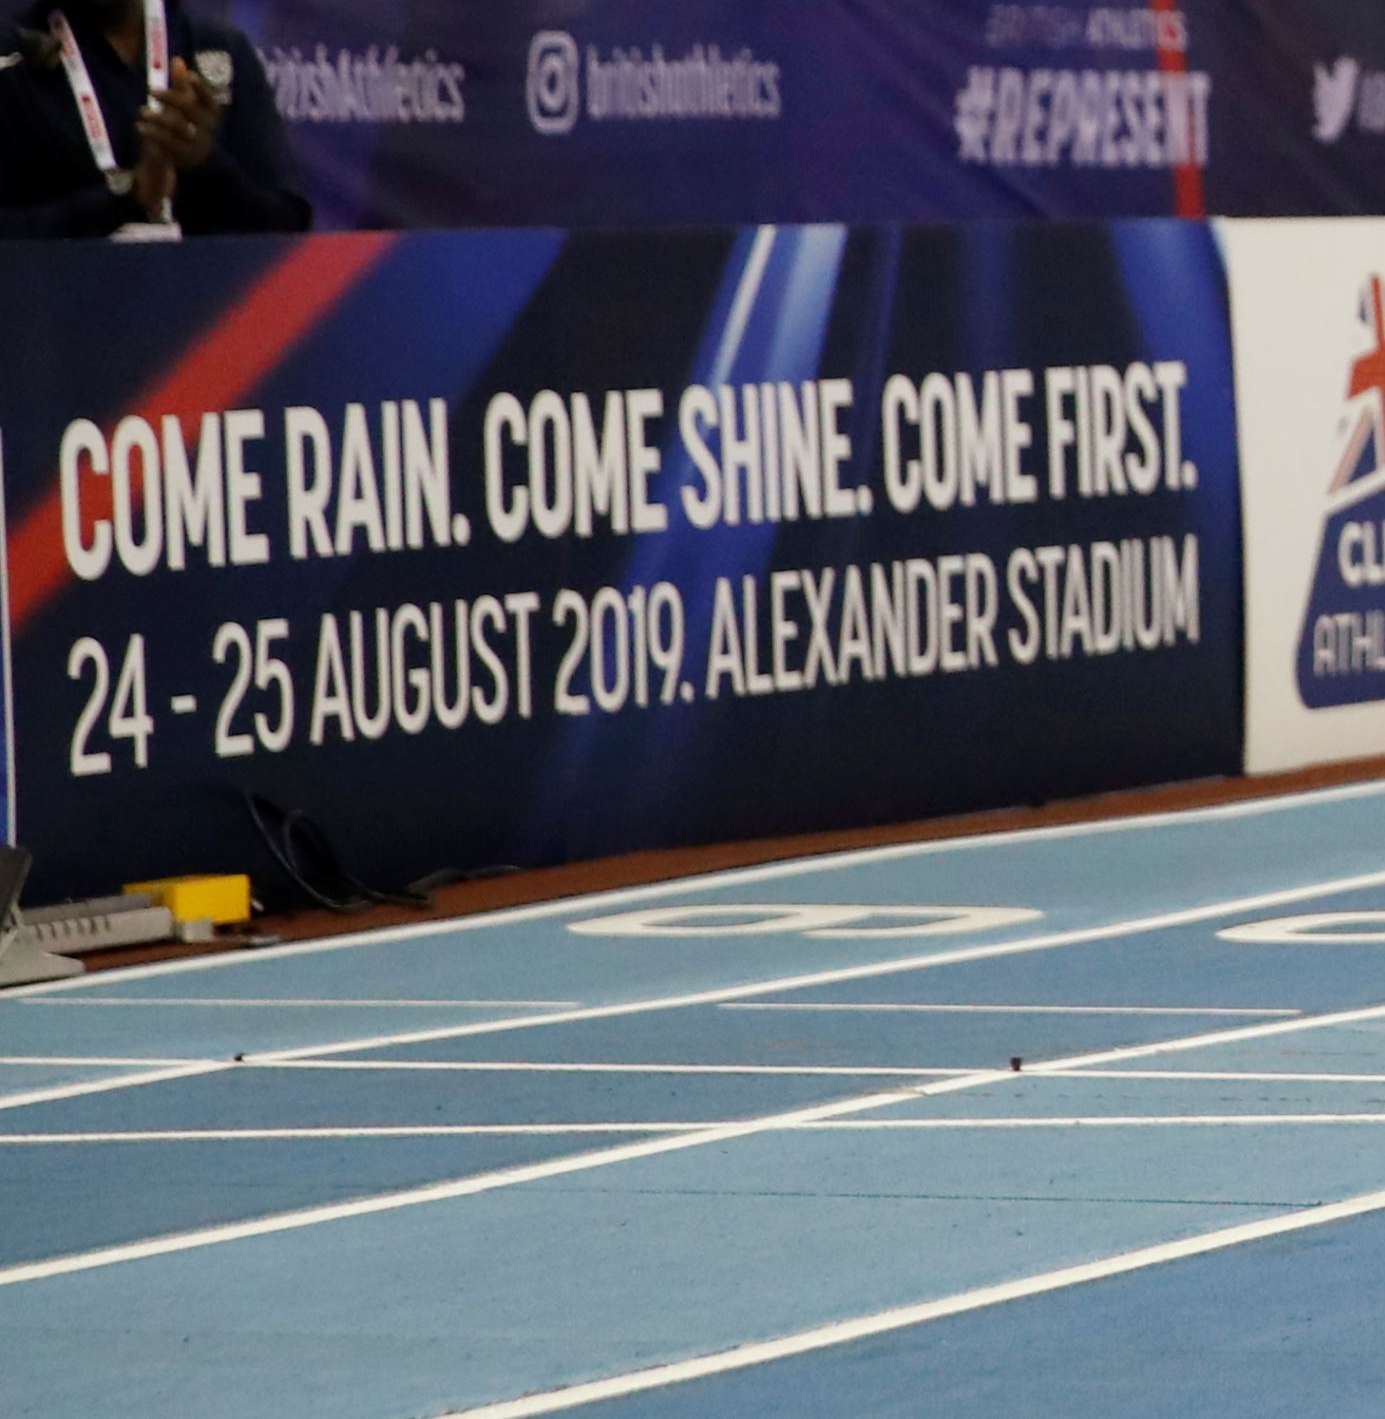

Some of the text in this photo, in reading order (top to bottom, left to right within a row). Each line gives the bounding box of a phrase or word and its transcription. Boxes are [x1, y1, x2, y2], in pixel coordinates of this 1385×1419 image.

[60, 360, 1197, 581] COME RAIN. COME SHINE. COME FIRST.
[68, 632, 154, 777] 24
[212, 618, 295, 758] 25
[310, 591, 539, 746] AUGUST
[553, 581, 695, 717] 2019.
[704, 552, 999, 700] ALEXANDER
[1006, 533, 1200, 666] STADIUM
